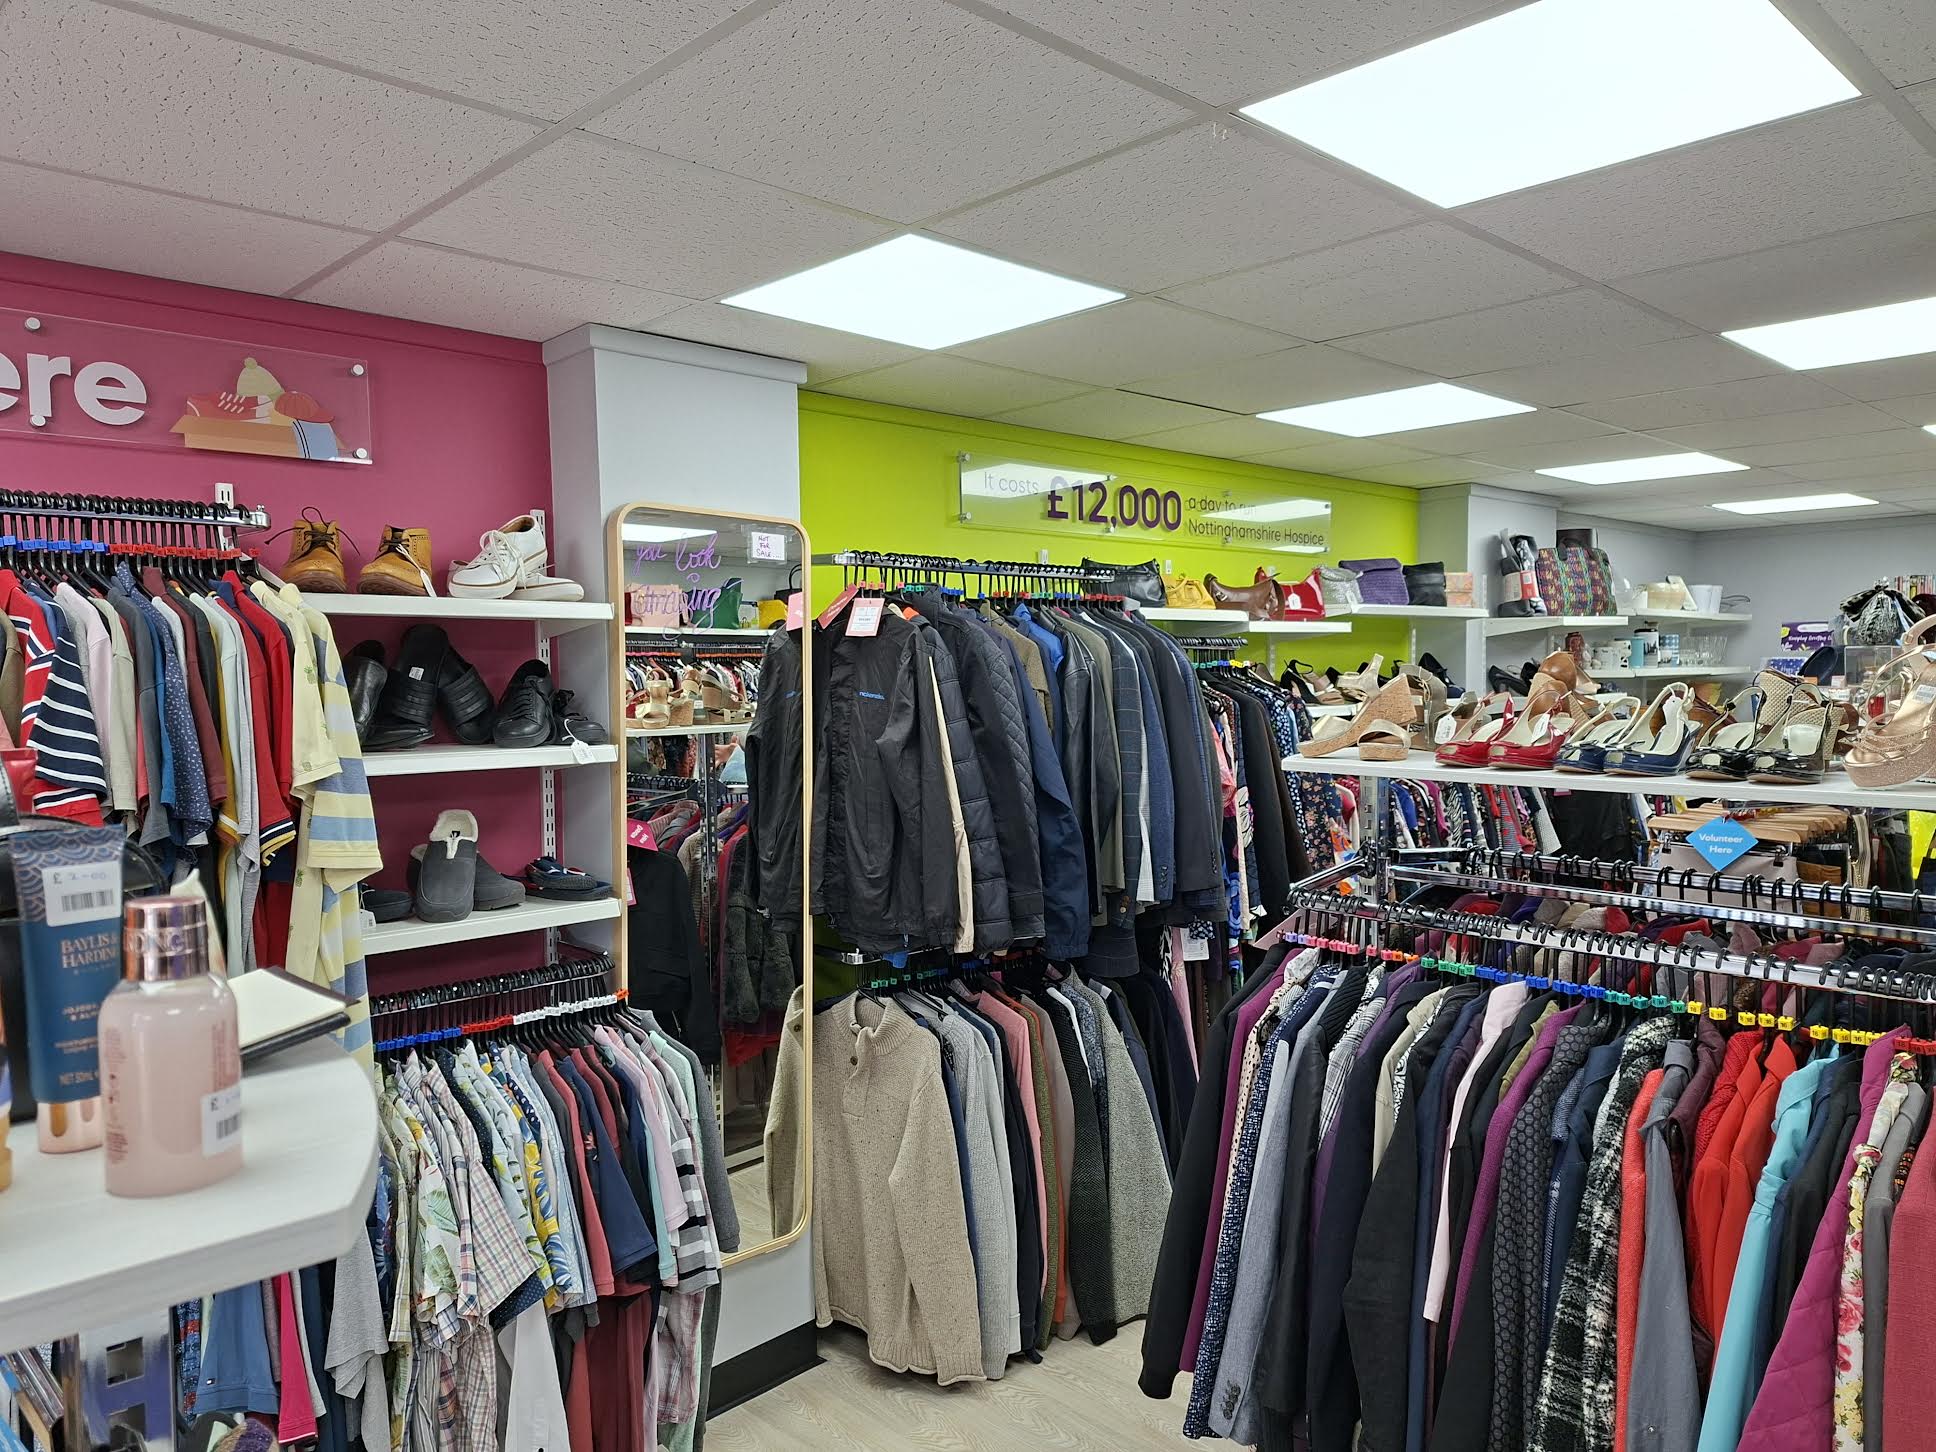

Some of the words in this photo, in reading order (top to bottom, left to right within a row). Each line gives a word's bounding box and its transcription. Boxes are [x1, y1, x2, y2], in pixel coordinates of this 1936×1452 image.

[0, 352, 147, 426] re
[984, 471, 994, 490] It
[998, 477, 1040, 495] costs
[1047, 475, 1182, 531] £12,000
[1188, 497, 1196, 509] a
[1199, 496, 1222, 512] day
[1225, 500, 1237, 511] to
[1188, 519, 1281, 542] Nottinghamshire
[1284, 528, 1324, 546] Hospice
[632, 544, 667, 576] you
[675, 532, 721, 571] look
[1698, 833, 1744, 844] Volunteer
[61, 933, 109, 954] BAYLIS
[62, 946, 117, 969] HARDIN
